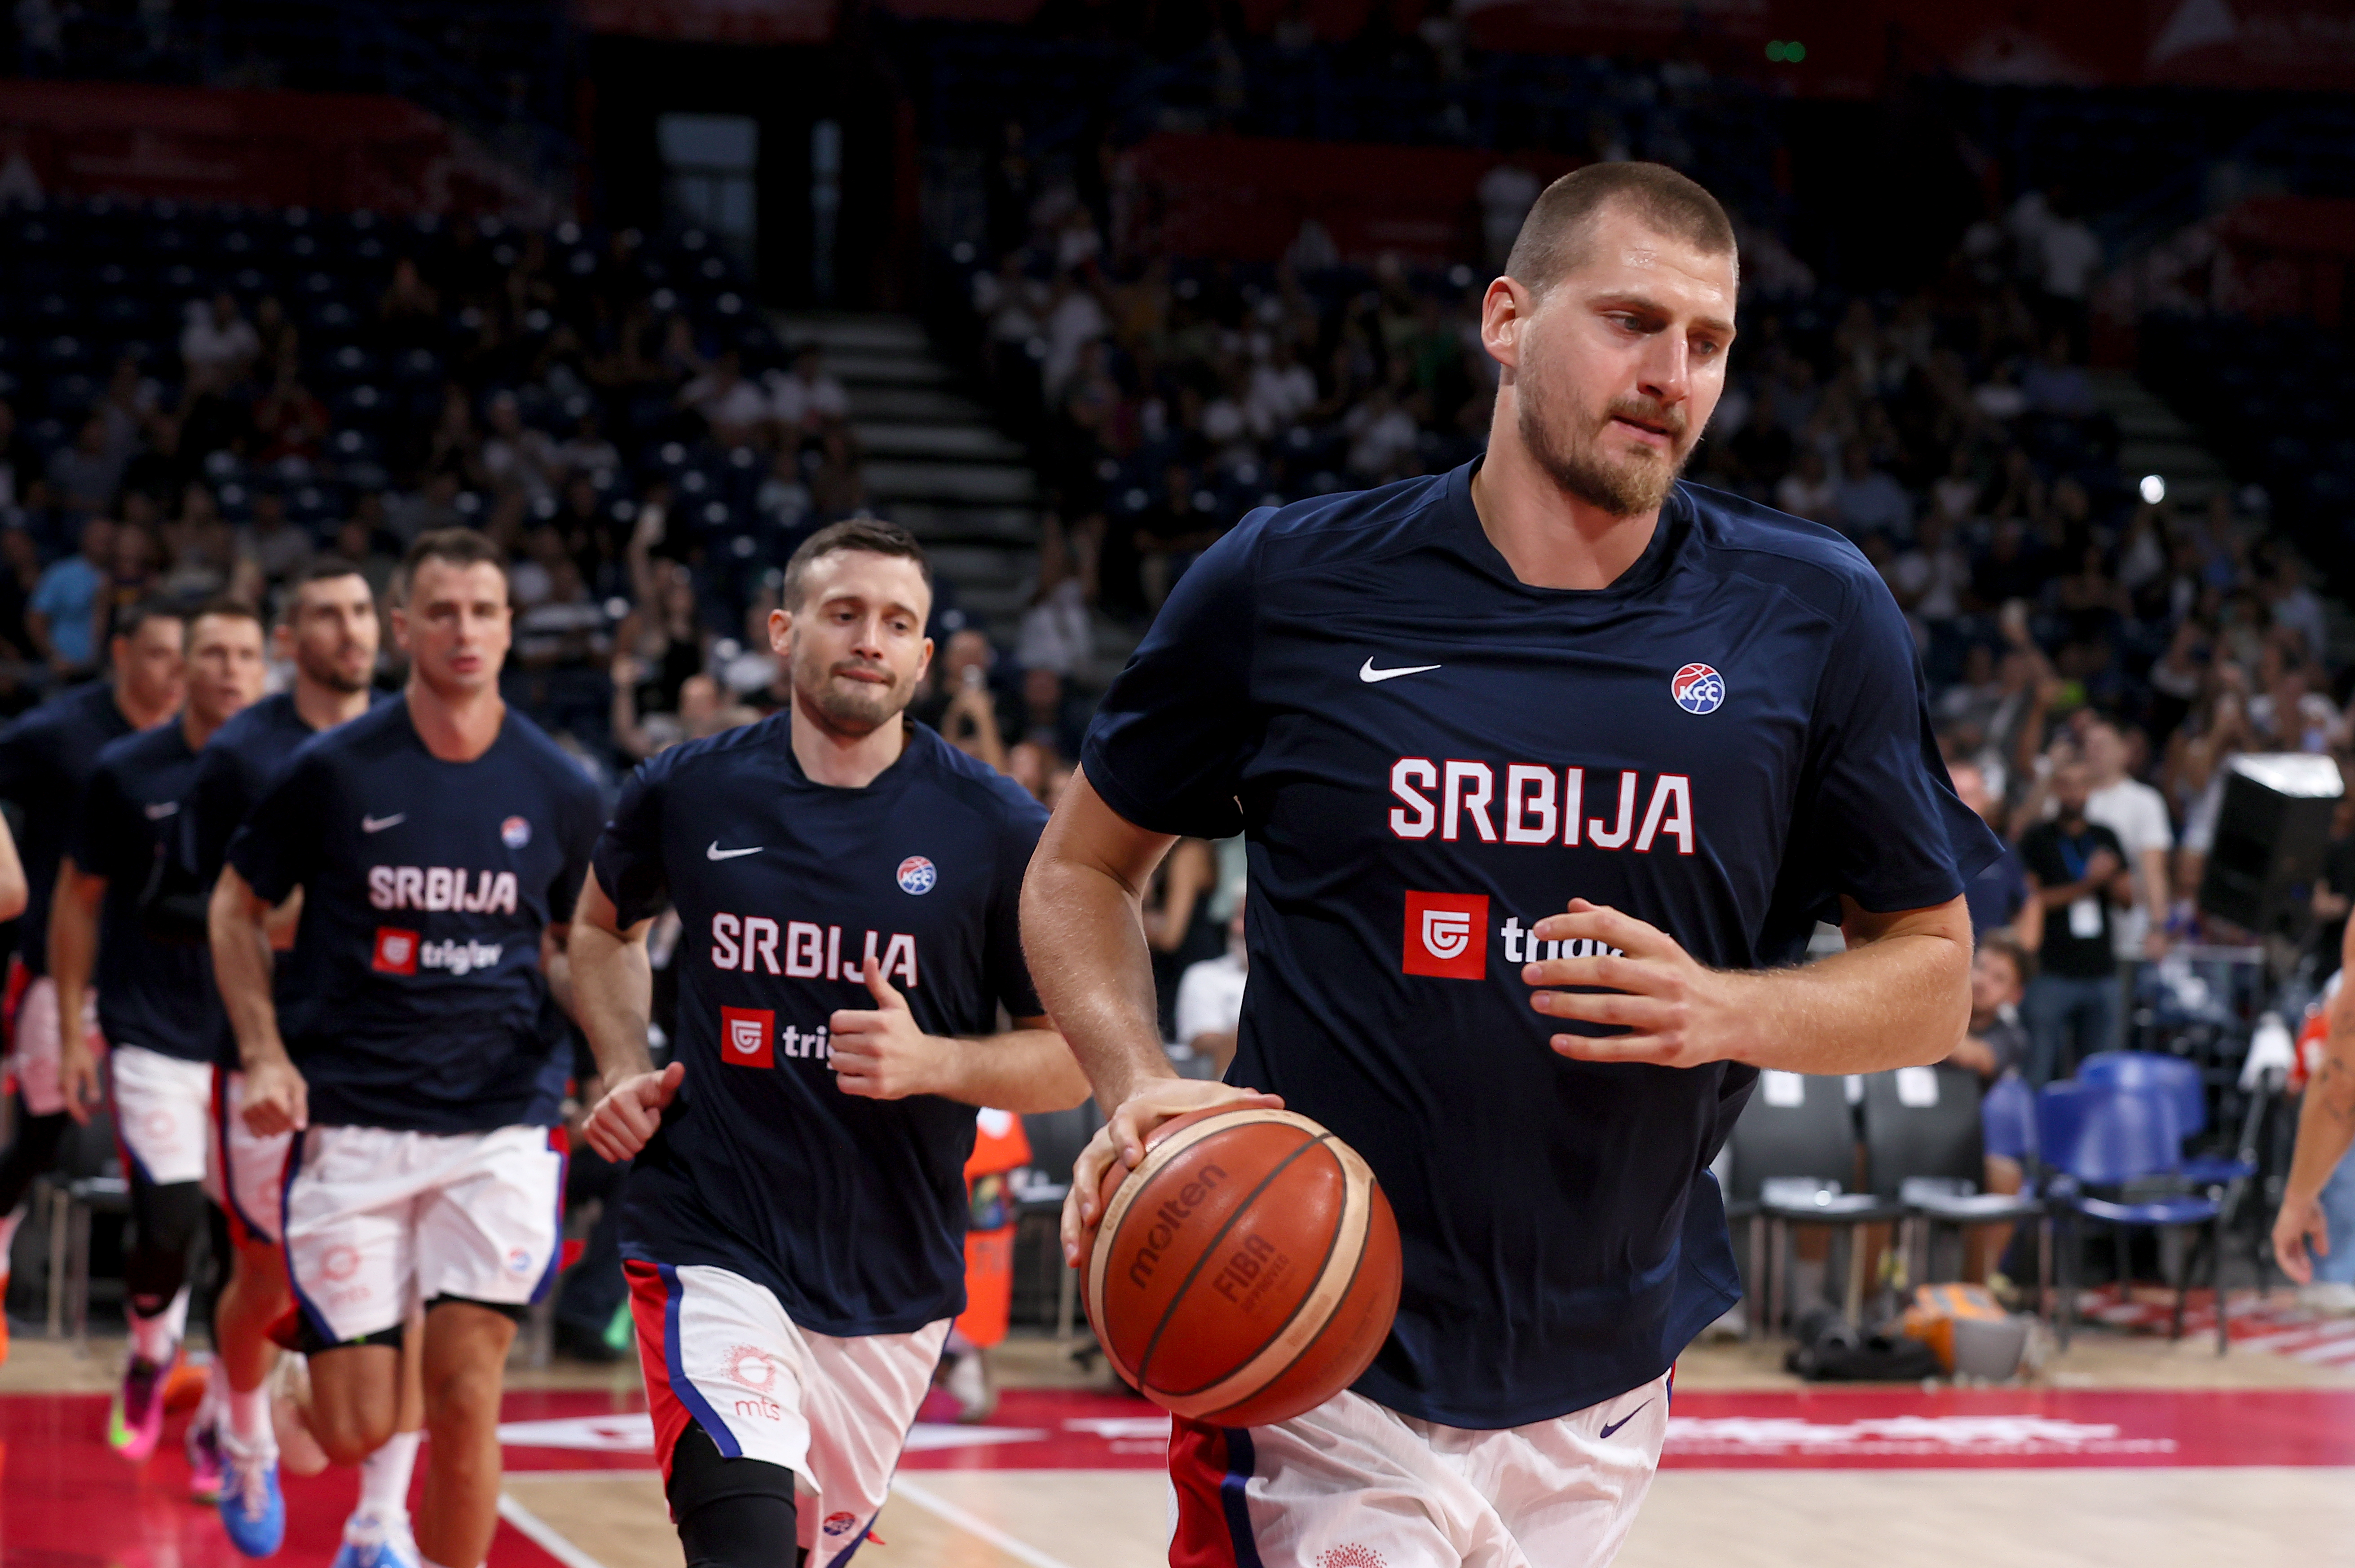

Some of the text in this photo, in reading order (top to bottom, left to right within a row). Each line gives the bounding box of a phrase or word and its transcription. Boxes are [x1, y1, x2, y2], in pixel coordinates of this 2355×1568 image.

[1388, 756, 1695, 855] SRBIJA
[368, 865, 518, 916] SRBIJA
[710, 912, 918, 988] SRBIJA
[1129, 1164, 1228, 1289] molten
[1213, 1234, 1275, 1303] FIBA
[734, 1396, 780, 1421] mts
